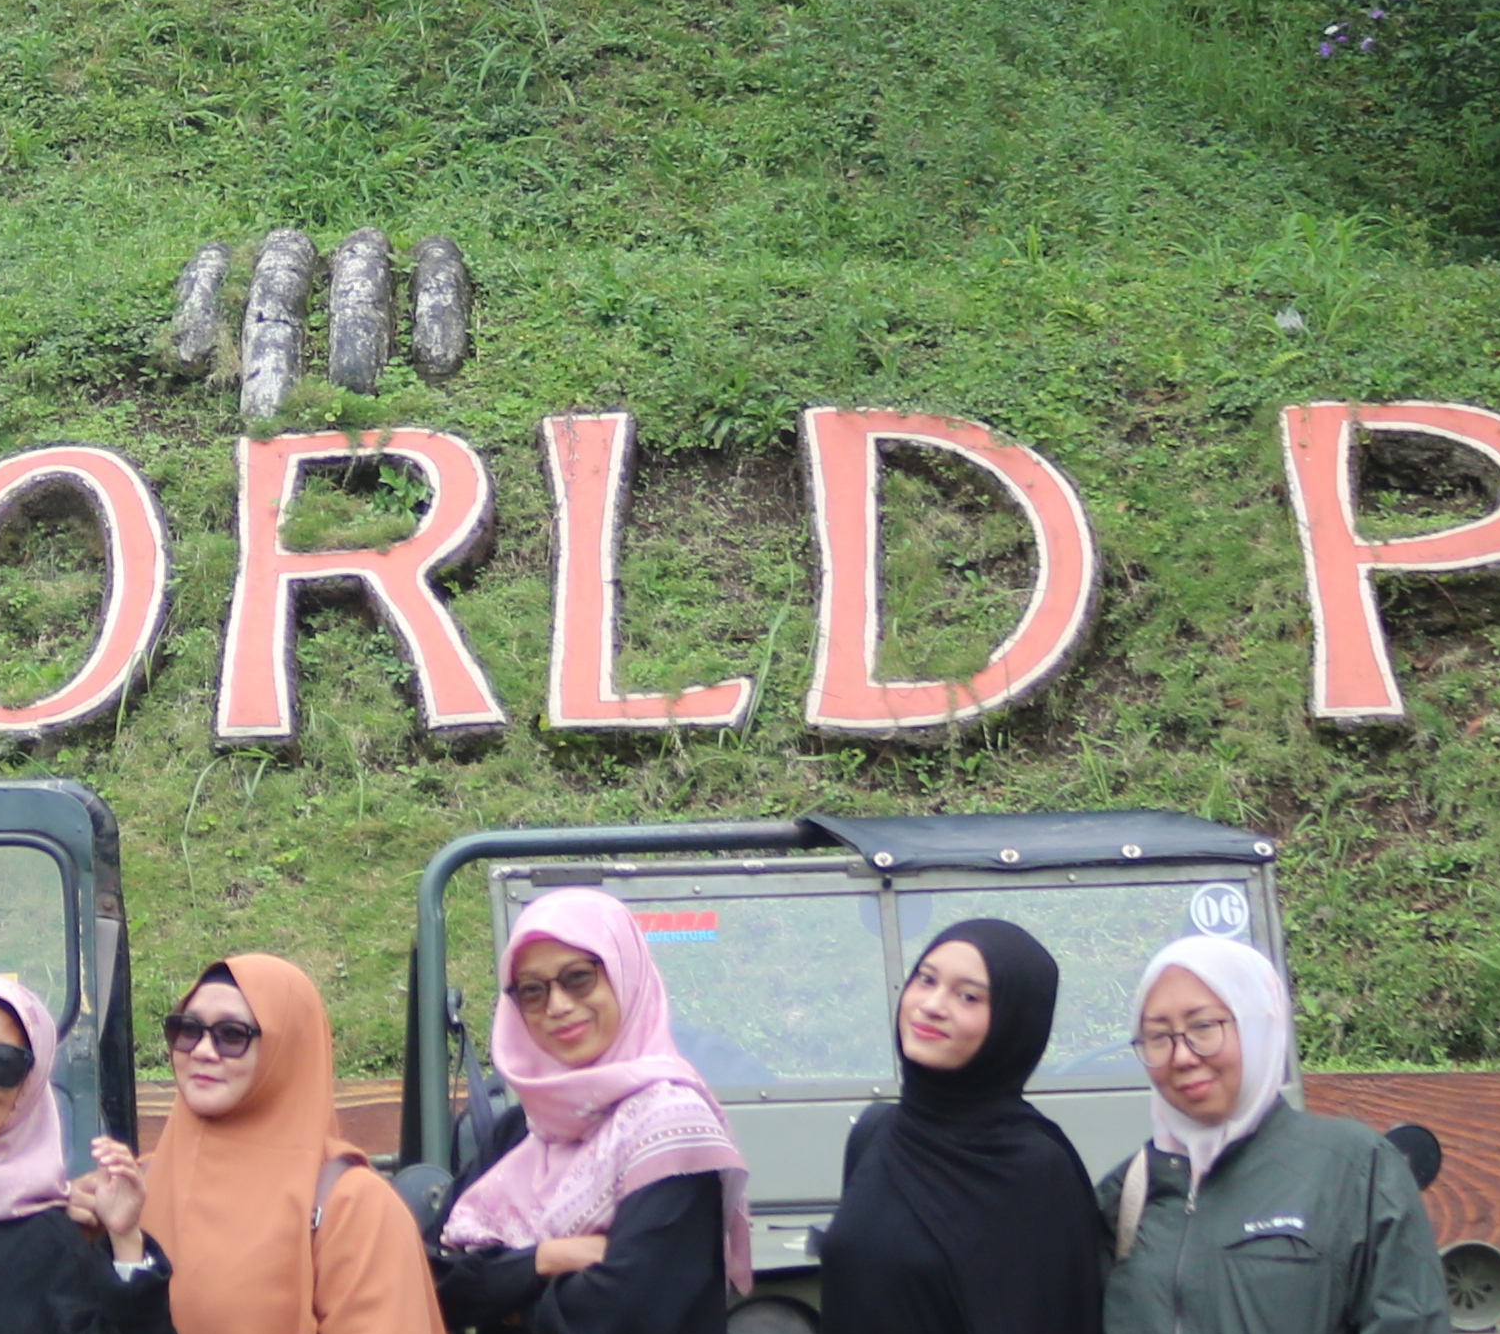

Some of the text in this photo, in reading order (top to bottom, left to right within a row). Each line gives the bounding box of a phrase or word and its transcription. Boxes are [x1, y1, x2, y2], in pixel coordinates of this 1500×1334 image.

[1197, 893, 1242, 927] 06
[633, 911, 718, 931] TARA
[645, 929, 717, 943] DVENTURE
